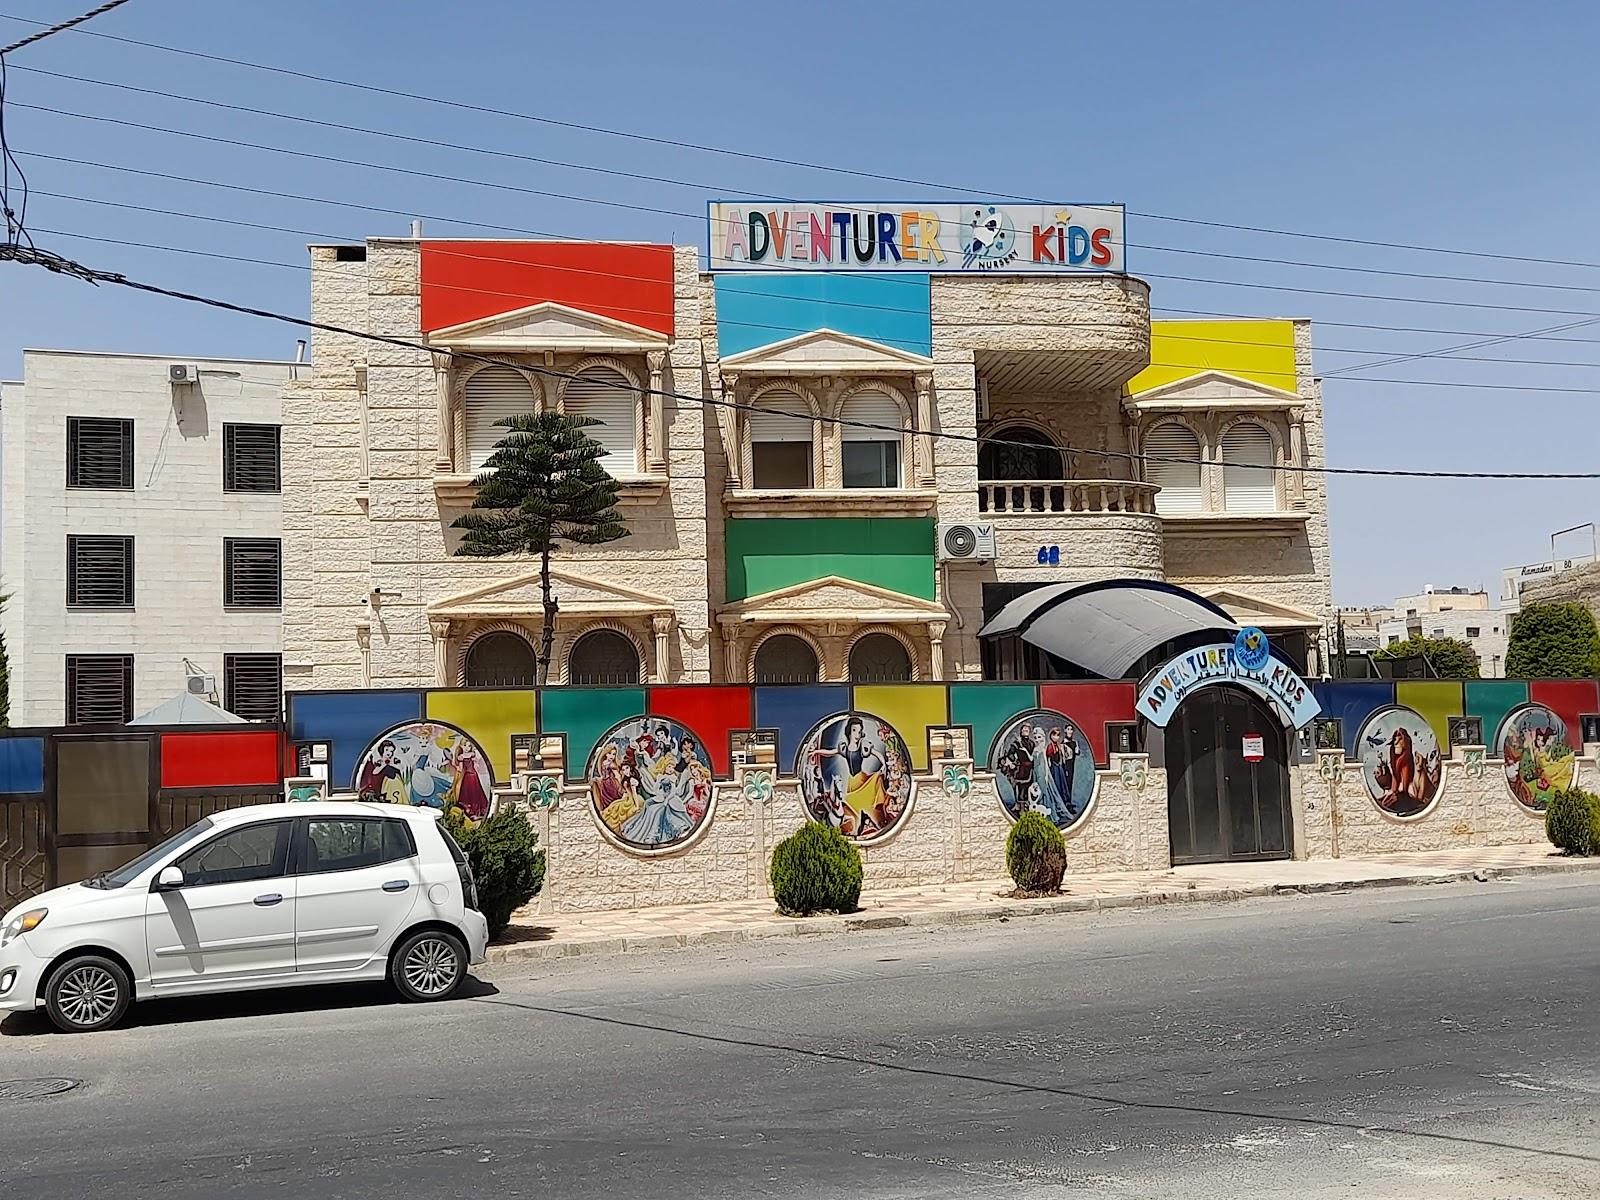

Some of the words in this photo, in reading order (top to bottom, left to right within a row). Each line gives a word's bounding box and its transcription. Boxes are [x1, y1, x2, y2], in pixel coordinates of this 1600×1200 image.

[724, 210, 946, 264] ADVENTURER
[1031, 212, 1112, 266] KIDS
[978, 249, 1019, 269] NURSERY
[1521, 563, 1553, 576] Ramadan
[1147, 648, 1236, 713] ADVENTURER
[1271, 664, 1305, 704] KIDS
